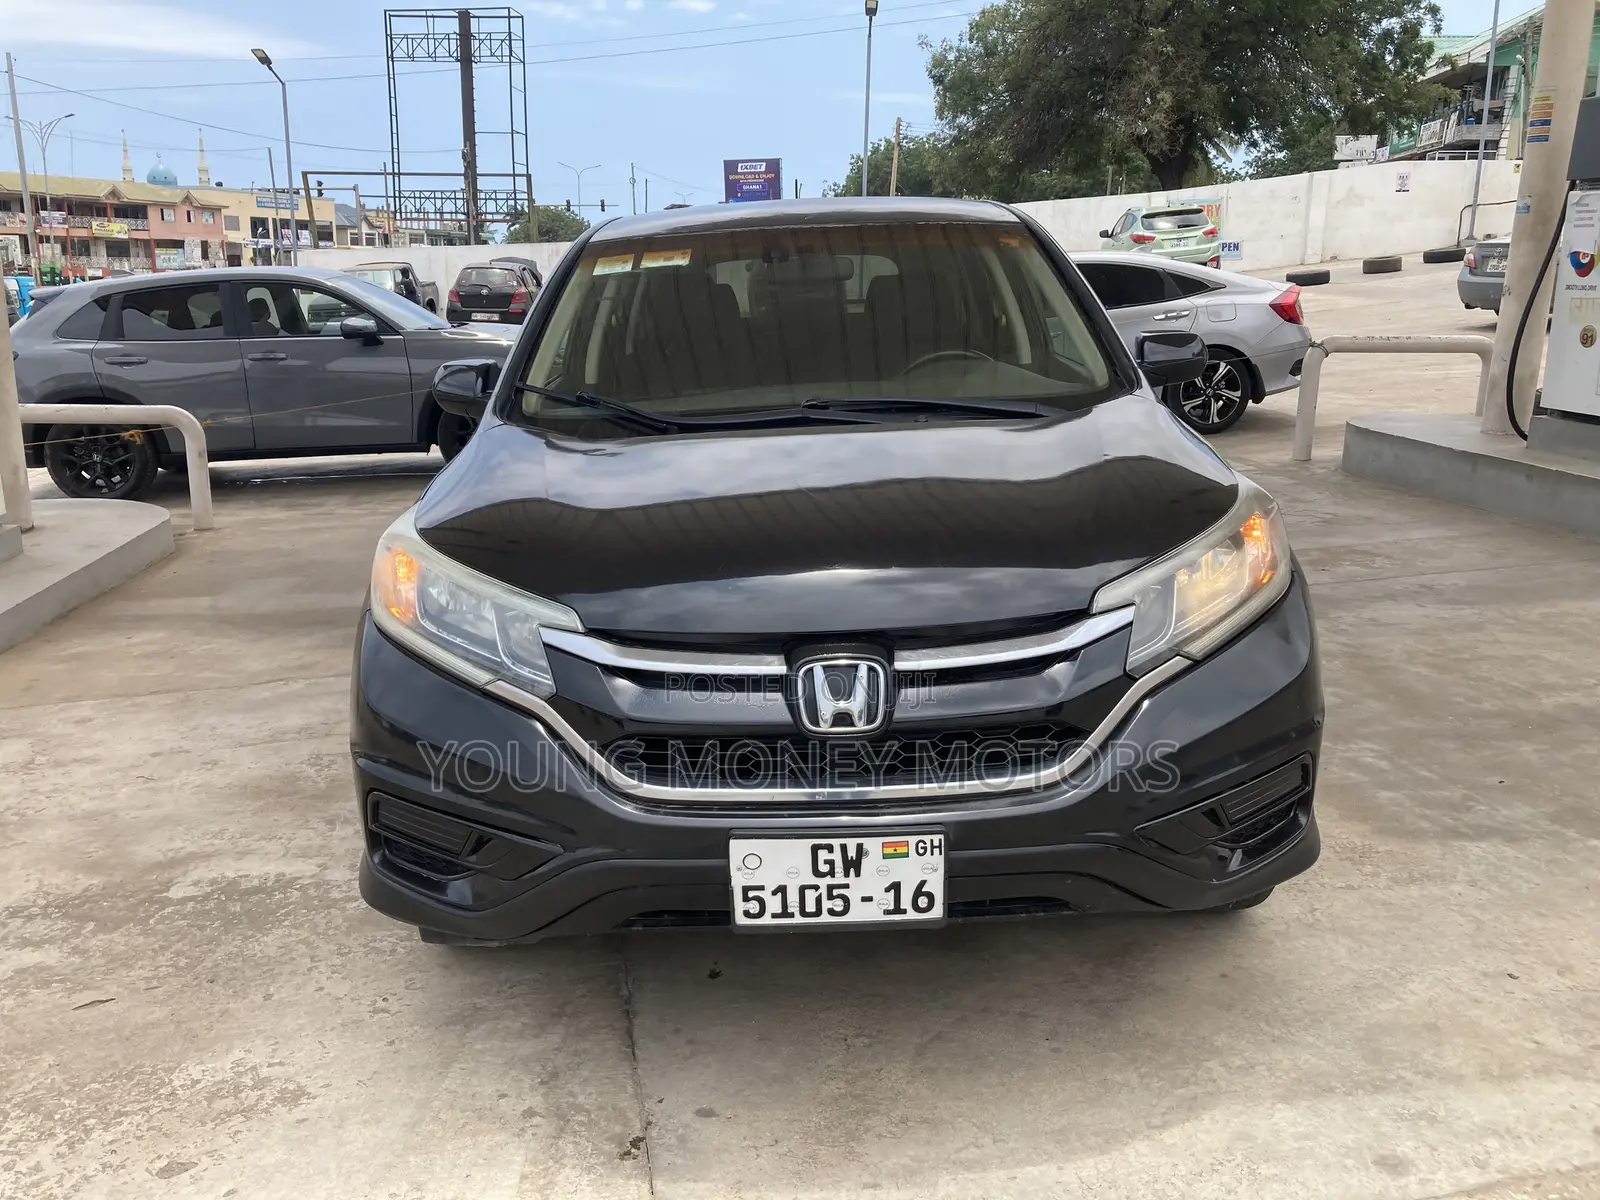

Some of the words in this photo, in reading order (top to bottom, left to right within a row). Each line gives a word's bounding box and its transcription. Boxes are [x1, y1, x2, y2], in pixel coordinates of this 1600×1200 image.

[1221, 242, 1240, 252] PEN
[1581, 332, 1594, 346] 91
[914, 838, 943, 857] GH
[810, 842, 864, 879] GW
[741, 879, 936, 919] 5105-16
